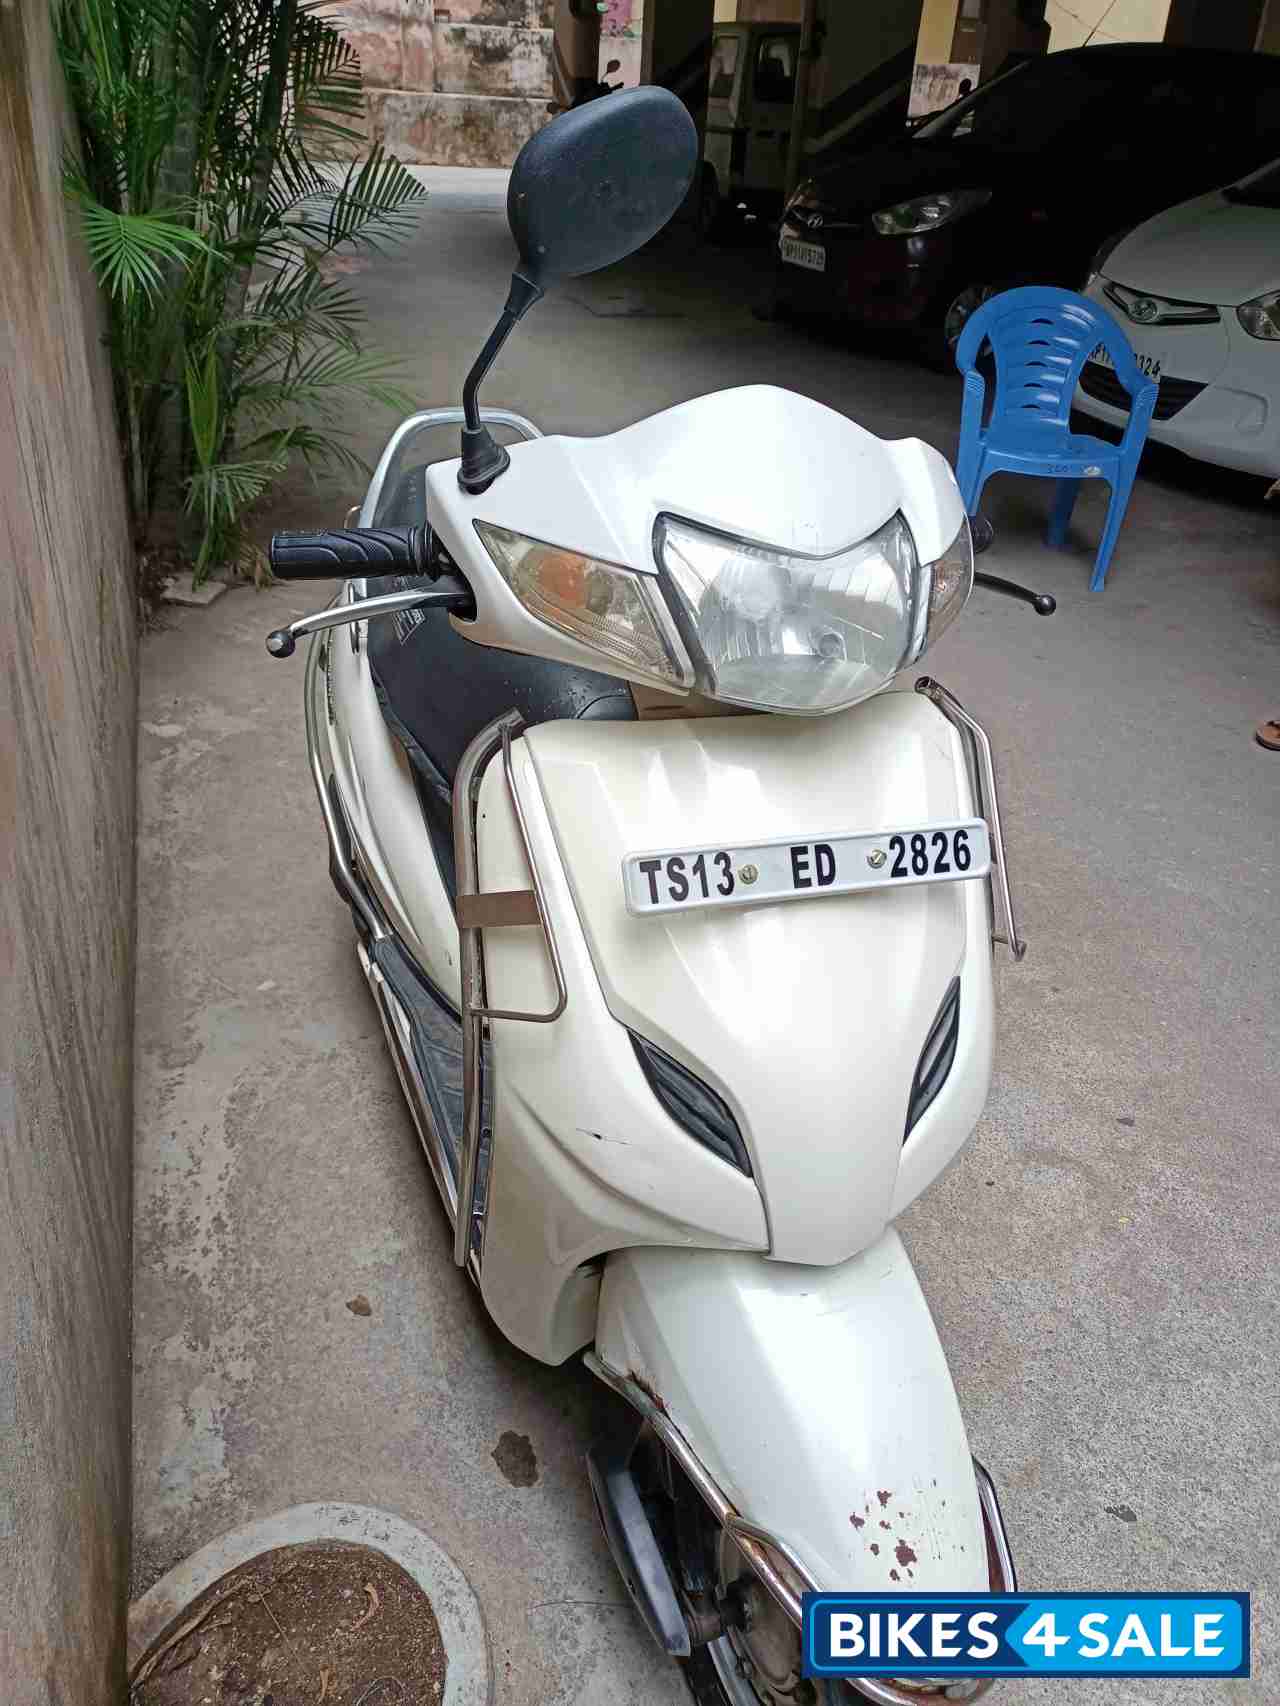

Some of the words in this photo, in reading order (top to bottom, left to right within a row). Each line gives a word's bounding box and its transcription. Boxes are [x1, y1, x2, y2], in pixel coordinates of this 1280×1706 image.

[639, 851, 735, 904] TS13
[790, 843, 836, 889] ED
[889, 829, 971, 878] 2826
